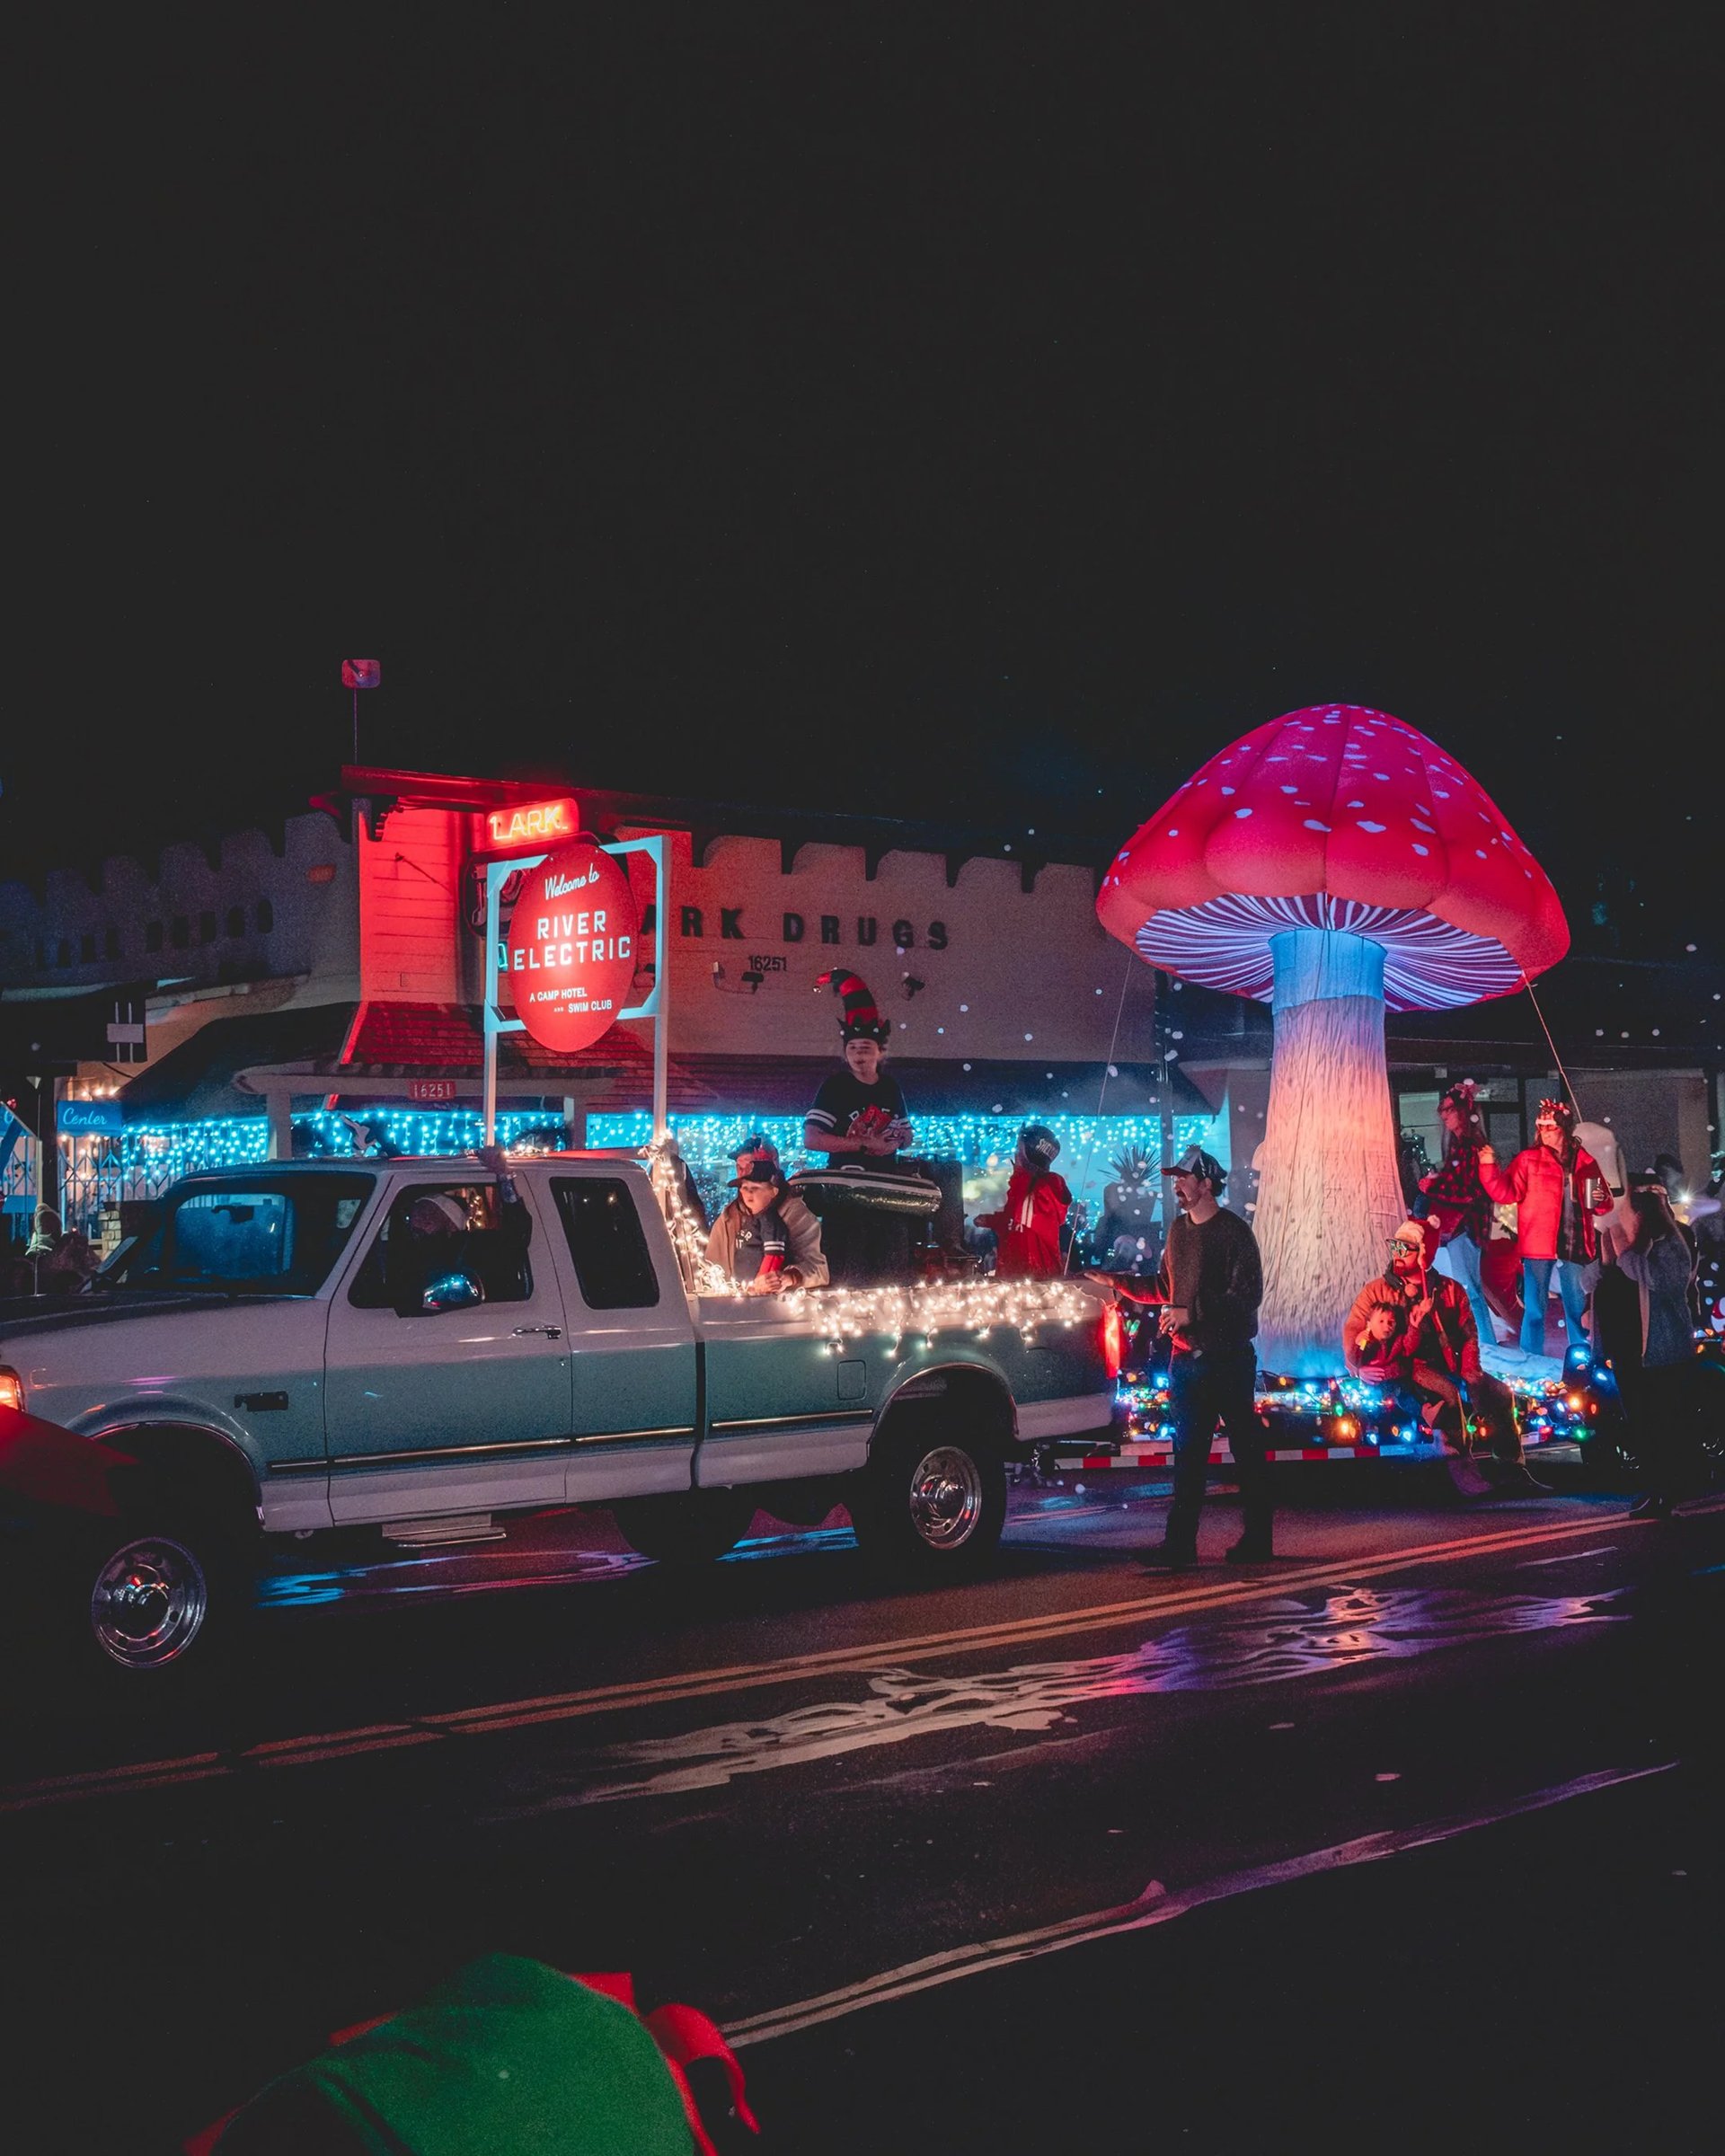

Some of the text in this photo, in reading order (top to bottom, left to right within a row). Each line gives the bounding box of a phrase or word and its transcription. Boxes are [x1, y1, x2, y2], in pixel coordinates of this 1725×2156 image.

[489, 804, 569, 841] LARK
[544, 862, 600, 901] Welcome to
[536, 909, 607, 941] RIVER
[782, 911, 950, 951] DRUGS
[513, 935, 632, 971] ELECTRIC
[748, 955, 788, 972] 16251
[529, 986, 588, 1003] A CAMP HOTEL
[568, 1002, 589, 1014] SWIM
[590, 999, 613, 1012] CLUB
[413, 1082, 451, 1098] 16251
[62, 1107, 108, 1126] Center
